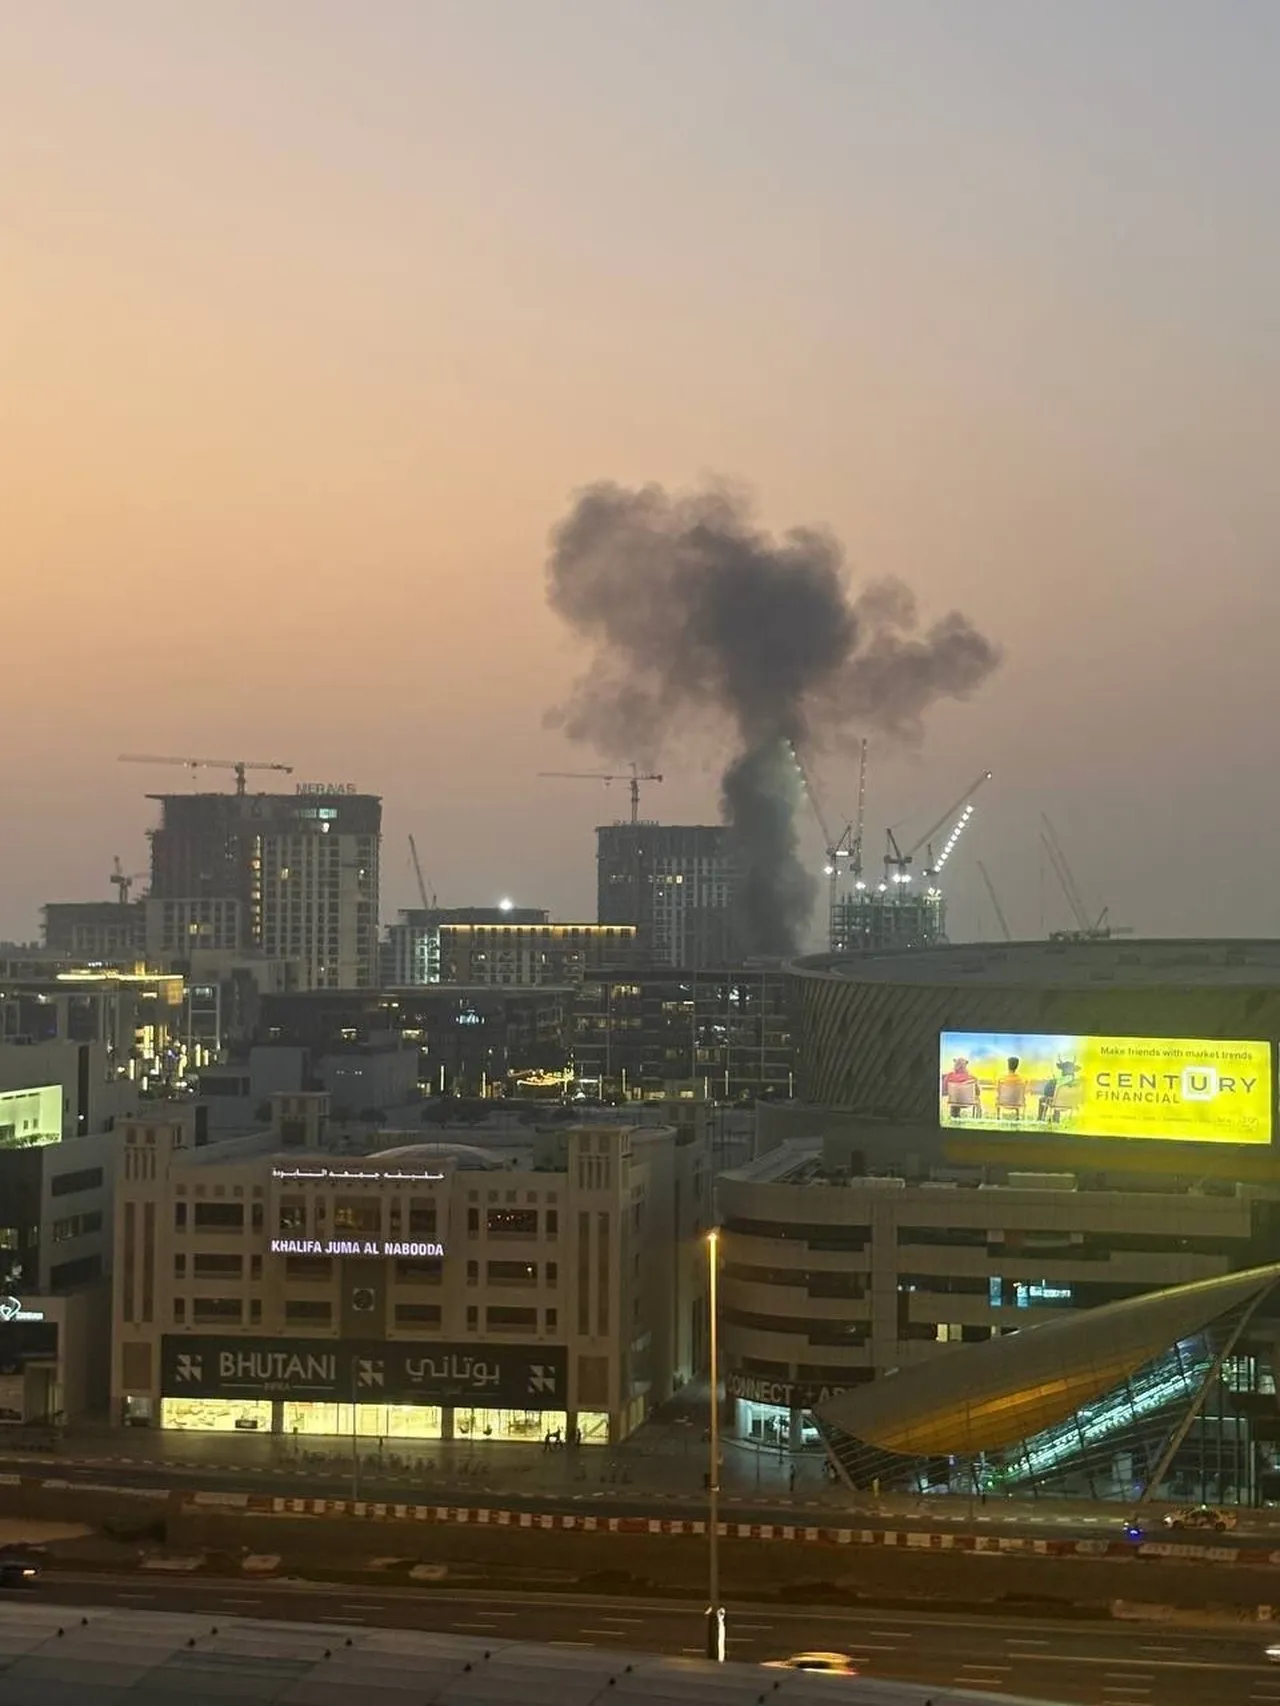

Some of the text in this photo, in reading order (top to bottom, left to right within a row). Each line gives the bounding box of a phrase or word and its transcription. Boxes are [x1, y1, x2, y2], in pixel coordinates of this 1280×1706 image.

[1100, 1046, 1253, 1061] Make friends with market trends
[1096, 1072, 1257, 1093] CENTURY
[1096, 1090, 1181, 1104] FINANCIAL
[271, 1240, 444, 1256] KHALIFA JUMA AL NABOODA
[219, 1352, 336, 1380] BHUTANI
[405, 1353, 500, 1386] بوتاني
